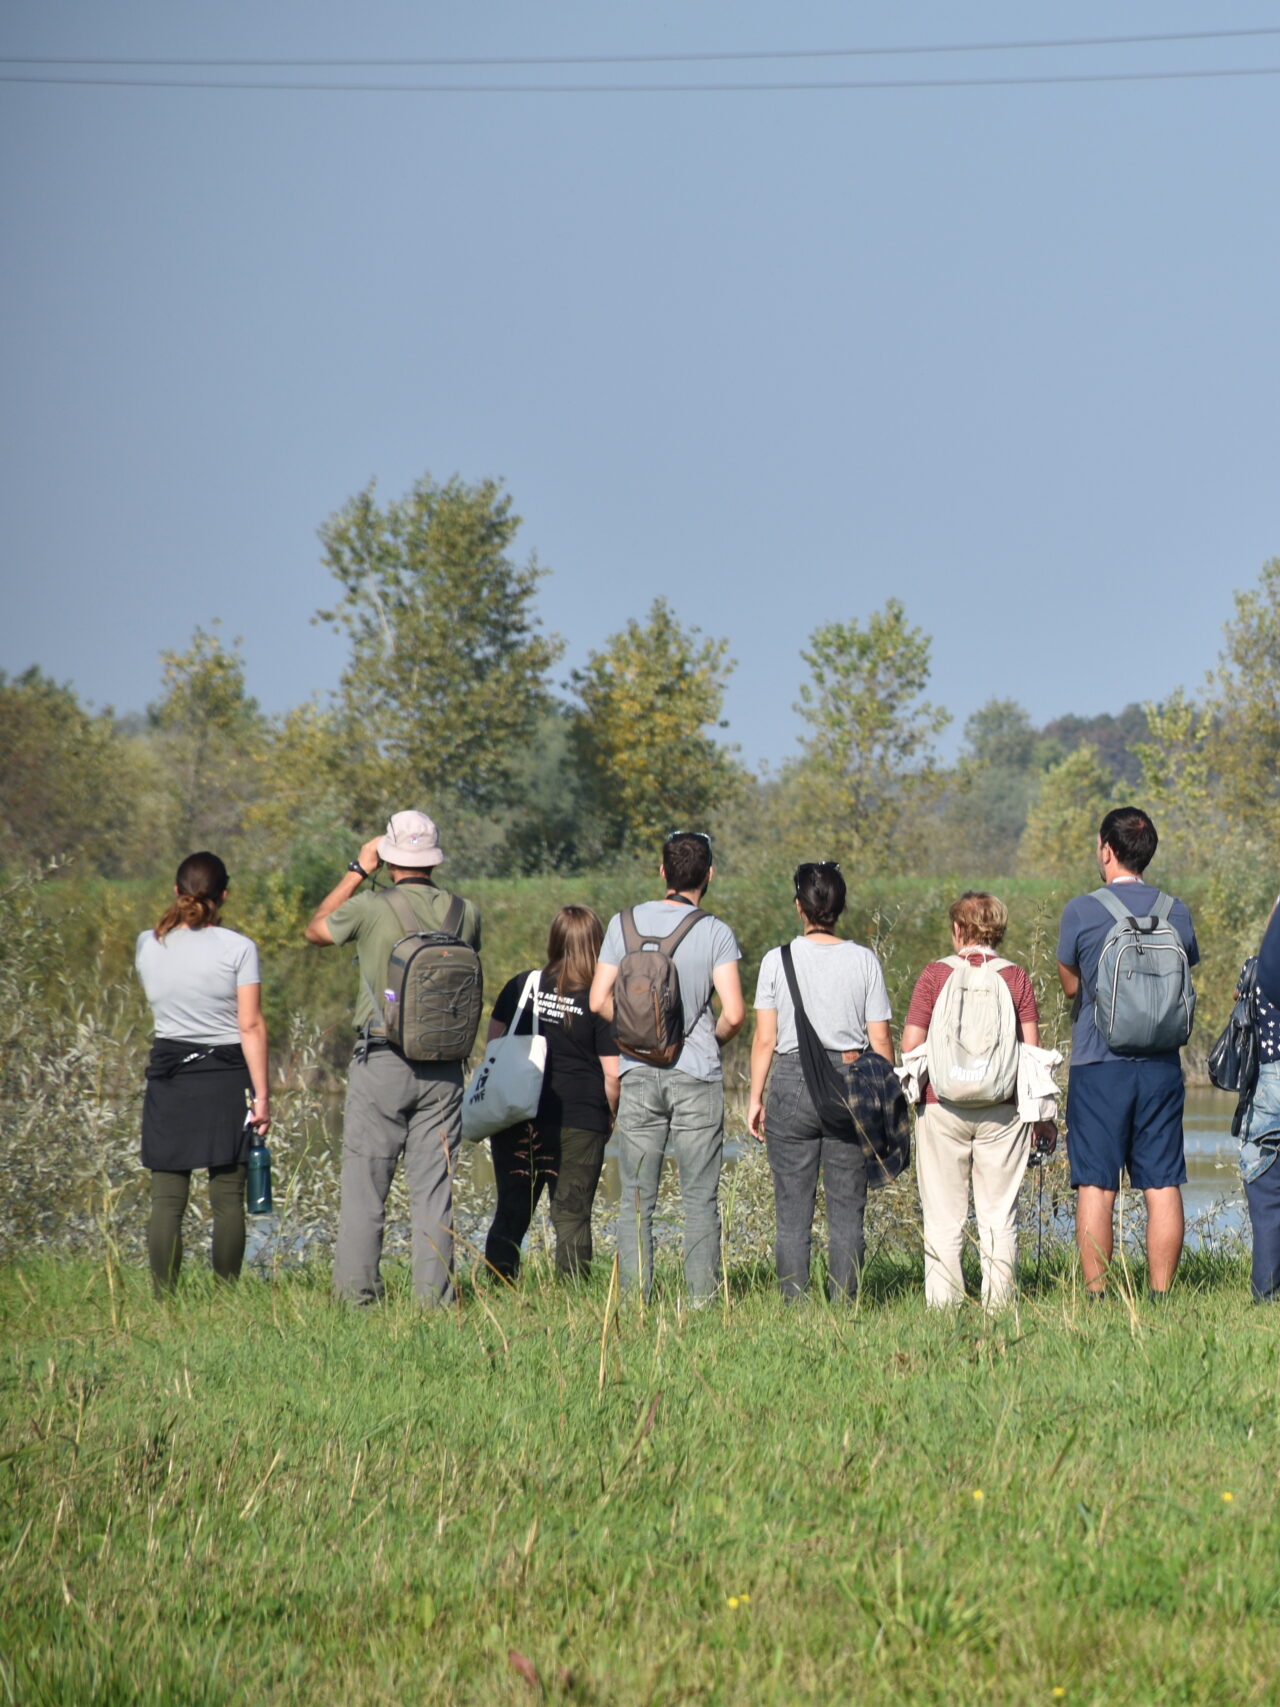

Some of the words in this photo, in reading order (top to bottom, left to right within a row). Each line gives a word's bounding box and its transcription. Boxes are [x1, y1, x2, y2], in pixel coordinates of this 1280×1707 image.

[544, 993, 558, 1001] ARE
[536, 999, 556, 1009] ANGE
[547, 1009, 565, 1018] DIETS
